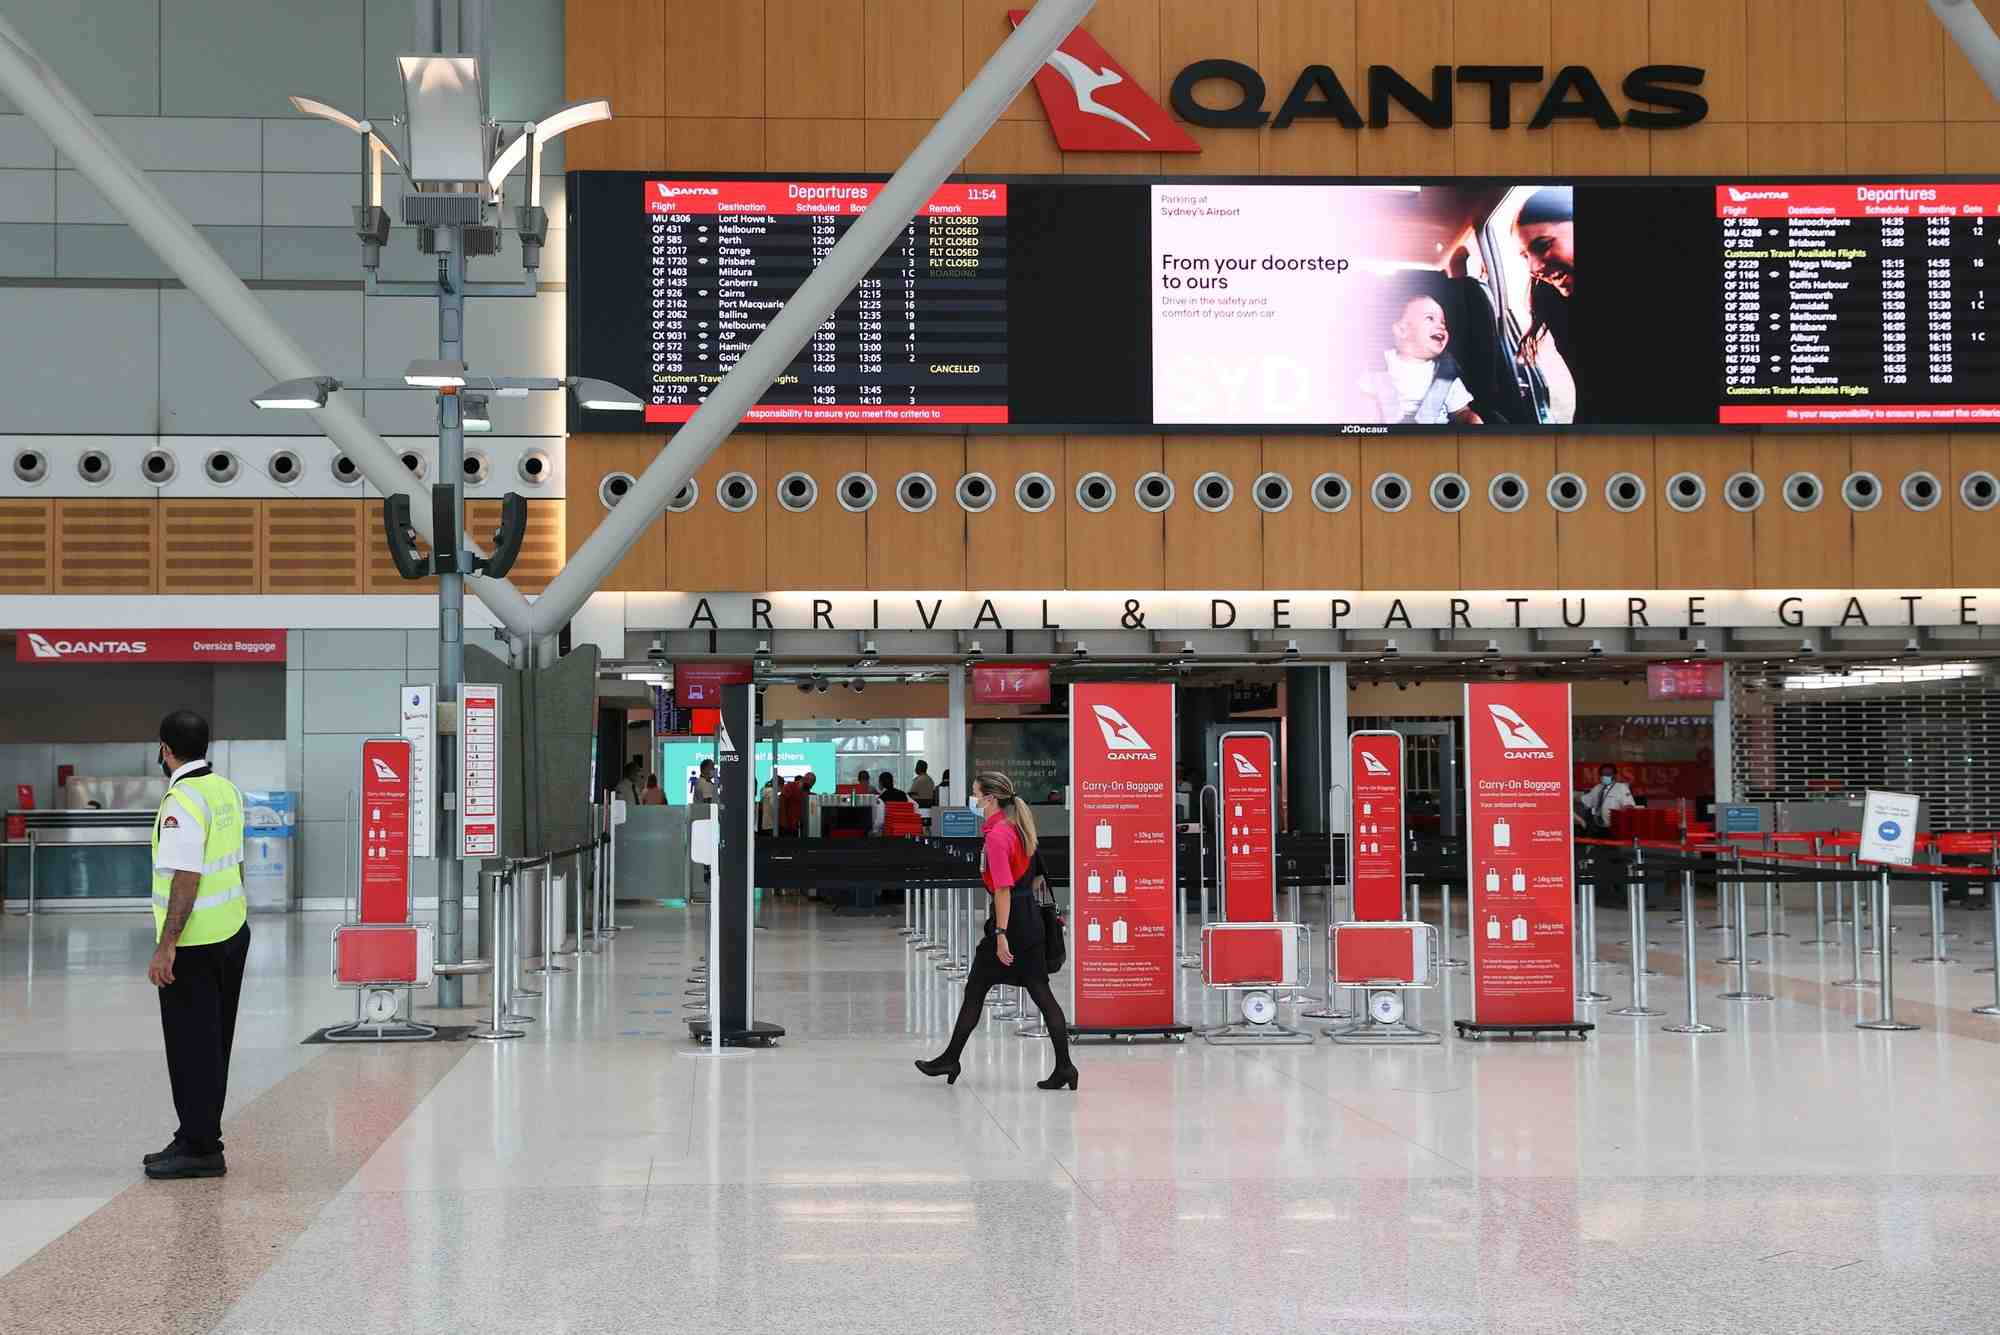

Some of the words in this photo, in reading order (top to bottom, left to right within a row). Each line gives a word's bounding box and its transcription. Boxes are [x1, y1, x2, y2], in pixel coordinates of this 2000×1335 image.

[1169, 58, 1708, 129] QANTAS
[672, 187, 719, 195] QANTAS
[788, 184, 868, 200] Departures
[968, 189, 996, 200] 11:54
[1857, 187, 1936, 203] Departures
[1161, 195, 1196, 206] Parking
[1198, 196, 1207, 204] at
[652, 202, 676, 212] Flight
[718, 202, 767, 211] Destination
[796, 203, 840, 212] Scheduled
[930, 204, 962, 213] Remark
[1161, 207, 1204, 217] Sydney's
[1206, 208, 1240, 217] Airport
[719, 215, 738, 223] Lord
[740, 215, 765, 223] Howe
[768, 215, 776, 223] Is.
[652, 225, 664, 233] QF
[667, 225, 681, 233] 431
[719, 225, 766, 233] Melbourne
[813, 226, 835, 234] 12:00
[929, 227, 943, 235] FLT
[946, 227, 978, 235] CLOSED
[719, 236, 741, 244] Perth
[718, 247, 750, 256] Orange
[929, 248, 943, 256] FLT
[946, 248, 978, 256] CLOSED
[1724, 250, 1768, 258] Customers
[1770, 250, 1795, 258] Travel
[1838, 250, 1866, 259] Flights
[929, 259, 943, 267] FLT
[946, 259, 978, 267] CLOSED
[1162, 255, 1209, 270] From
[1215, 257, 1257, 274] your
[1262, 255, 1349, 274] doorstep
[652, 268, 664, 276] QF
[667, 268, 687, 276] 1403
[719, 268, 752, 276] Mildura
[719, 279, 758, 287] Canberra
[1162, 275, 1181, 289] to
[1187, 277, 1228, 289] ours
[652, 289, 664, 297] QF
[667, 289, 682, 297] 926
[719, 289, 745, 297] Cairns
[652, 300, 664, 308] QF
[667, 300, 687, 308] 2162
[719, 300, 737, 309] Port
[740, 300, 784, 310] Macquarie
[859, 301, 881, 309] 12:25
[1162, 296, 1186, 305] Drive
[1189, 296, 1197, 305] in
[1200, 296, 1214, 305] the
[1218, 296, 1246, 307] safety
[1248, 296, 1267, 305] and
[719, 311, 748, 319] Ballina
[1162, 309, 1199, 318] comfort
[1202, 309, 1212, 318] of
[1215, 311, 1235, 319] your
[652, 321, 664, 329] QF
[667, 321, 682, 329] 435
[719, 322, 766, 330] Melbourne
[652, 332, 664, 340] CX
[667, 332, 687, 340] 9031
[719, 332, 736, 340] ASP
[719, 354, 739, 362] Gold
[813, 354, 835, 362] 13:25
[813, 365, 835, 373] 14:00
[930, 365, 980, 373] CANCELLED
[652, 374, 697, 383] Customers
[813, 397, 835, 405] 14:30
[859, 397, 881, 405] 14:10
[1342, 425, 1388, 433] JCDecaux
[689, 598, 1060, 630] ARRIVAL
[1121, 598, 1146, 630] &
[1211, 596, 1705, 630] DEPARTURE
[55, 642, 146, 654] QANTAS
[193, 642, 232, 651] Oversize
[235, 642, 276, 654] Baggage
[1108, 752, 1157, 760] QANTAS
[1082, 781, 1124, 792] Carry-On
[1126, 782, 1164, 792] Baggage
[1479, 780, 1521, 790] Carry-On
[1524, 780, 1560, 791] Baggage
